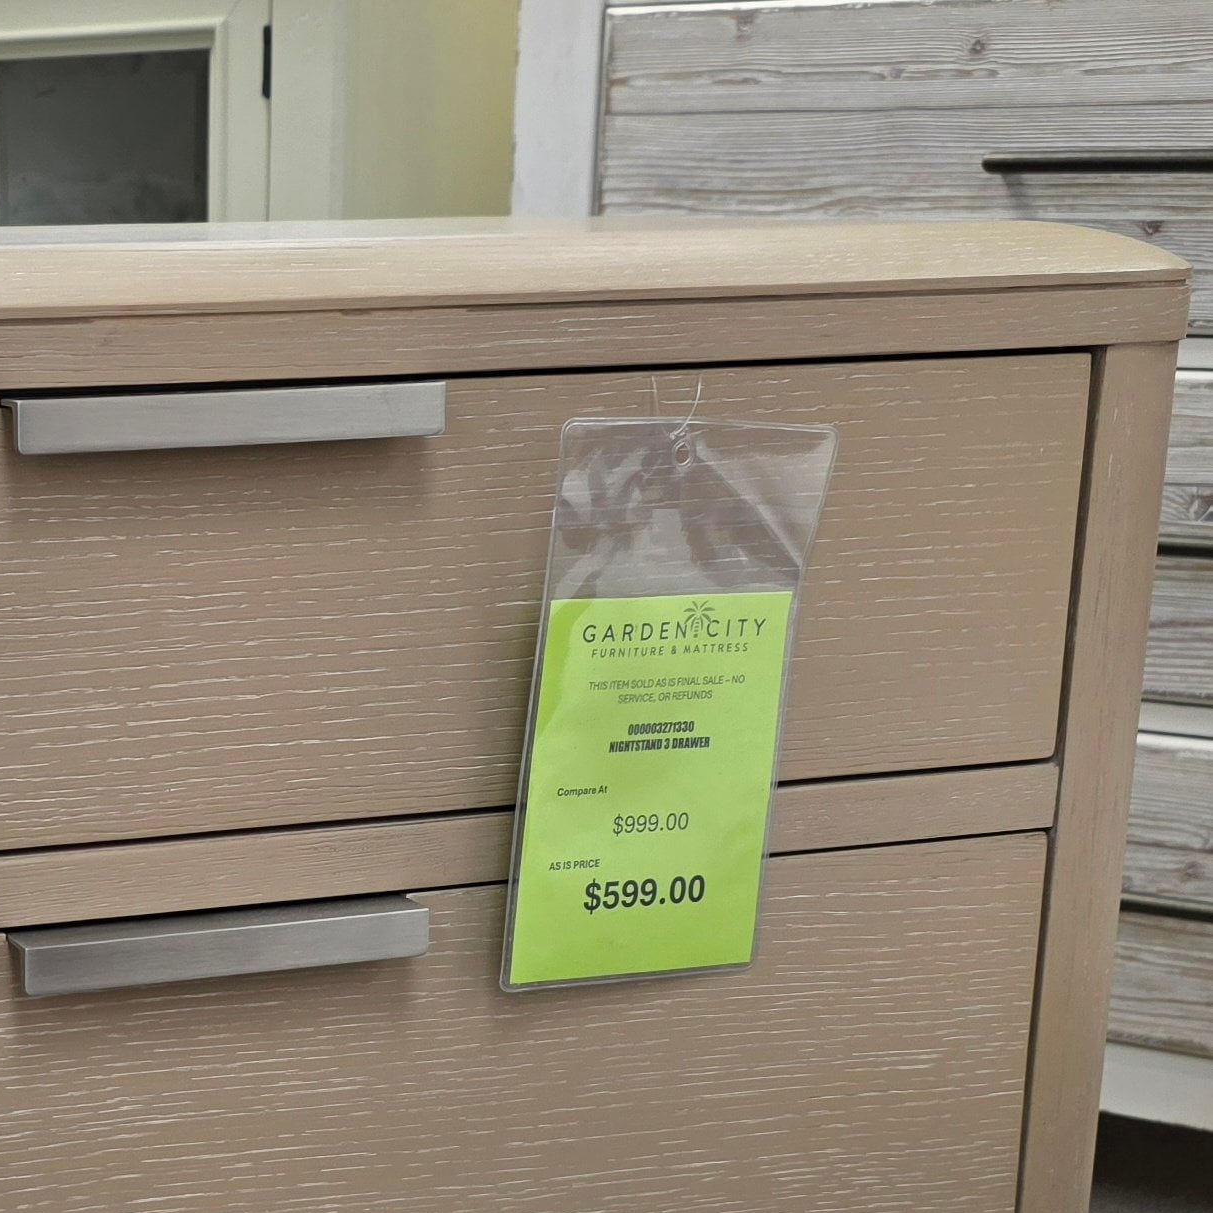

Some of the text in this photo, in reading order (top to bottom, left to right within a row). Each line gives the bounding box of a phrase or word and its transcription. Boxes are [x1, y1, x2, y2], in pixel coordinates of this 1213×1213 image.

[582, 618, 767, 643] GARDEN CITY
[591, 642, 749, 658] FURNITURE & MATTRESS
[589, 681, 608, 691] THIS
[609, 680, 630, 690] ITEM
[630, 679, 655, 689] SOLD
[655, 678, 667, 688] AS
[668, 678, 677, 687] IS
[677, 677, 701, 687] FINAL
[702, 675, 725, 685] SALE
[731, 674, 746, 684] NO
[658, 692, 671, 702] OR
[671, 690, 713, 701] REFUNDS
[609, 736, 711, 753] NIGHTSTAND 3 DRAWER
[557, 785, 608, 798] Compare At
[612, 812, 689, 837] $999.00
[549, 858, 601, 871] AS IS PRICE
[583, 874, 706, 915] $599.00
